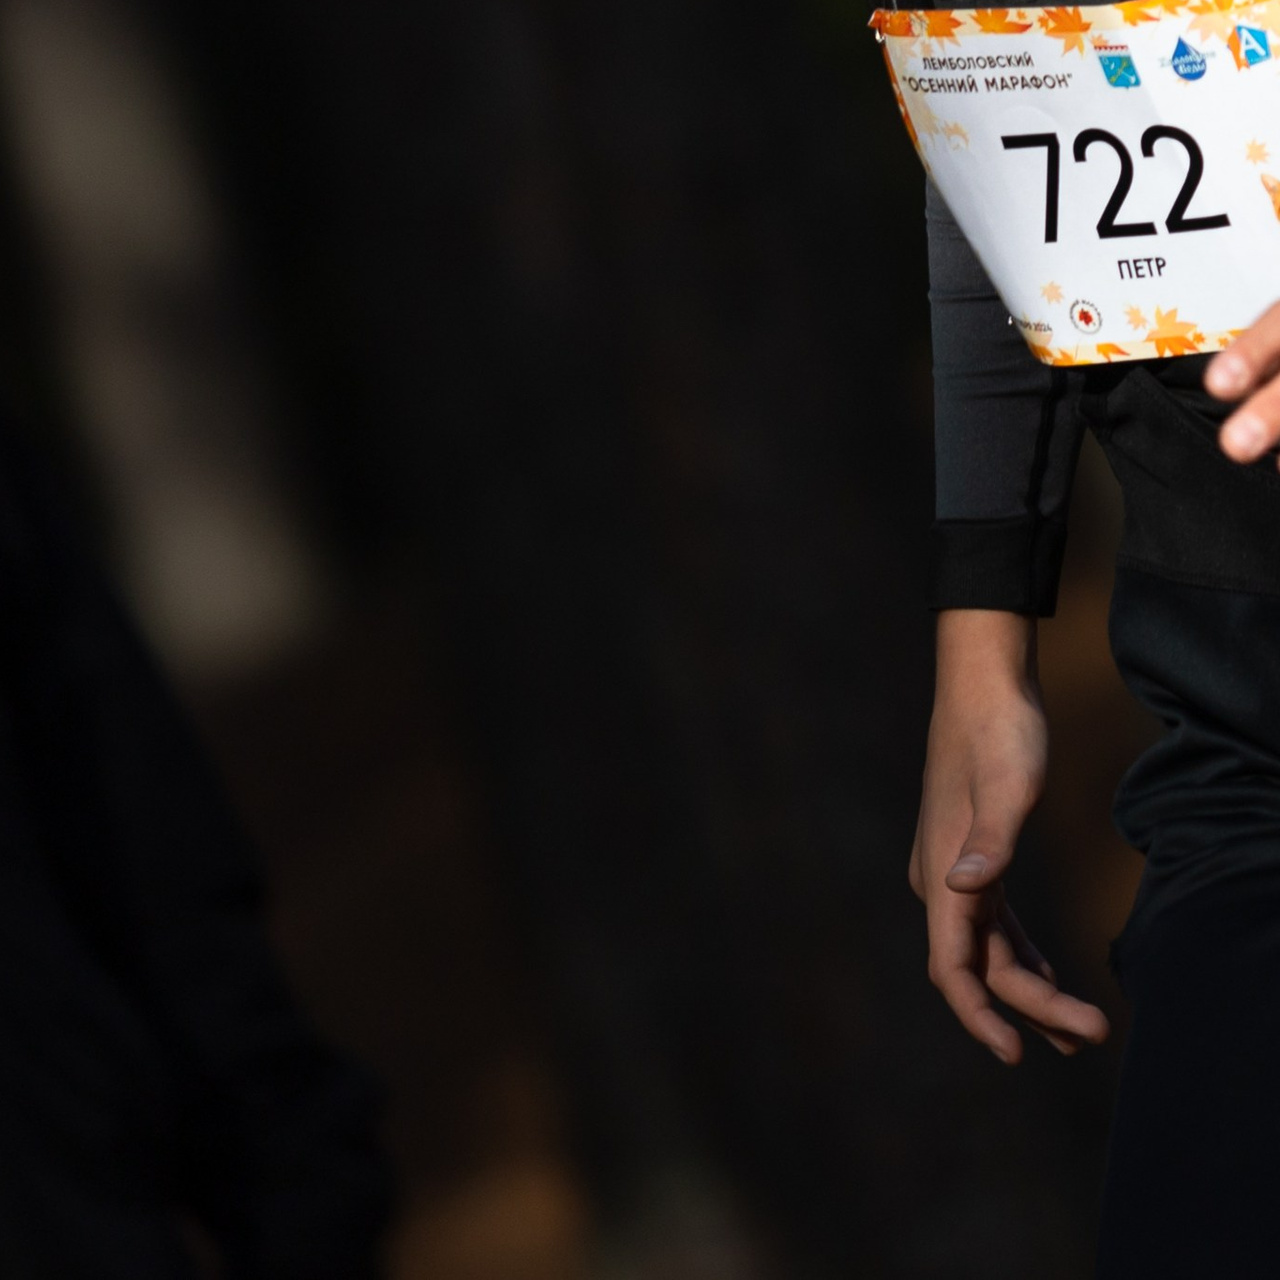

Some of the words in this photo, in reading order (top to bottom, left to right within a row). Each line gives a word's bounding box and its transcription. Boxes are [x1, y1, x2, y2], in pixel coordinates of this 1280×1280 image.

[922, 51, 1035, 70] ЛЕМБОЛОВСКИЙ
[902, 75, 978, 94] "ОСЕННИЙ
[985, 73, 1073, 93] МАРАФОН"
[1000, 124, 1231, 244] 722
[1117, 257, 1167, 280] ПЕТР
